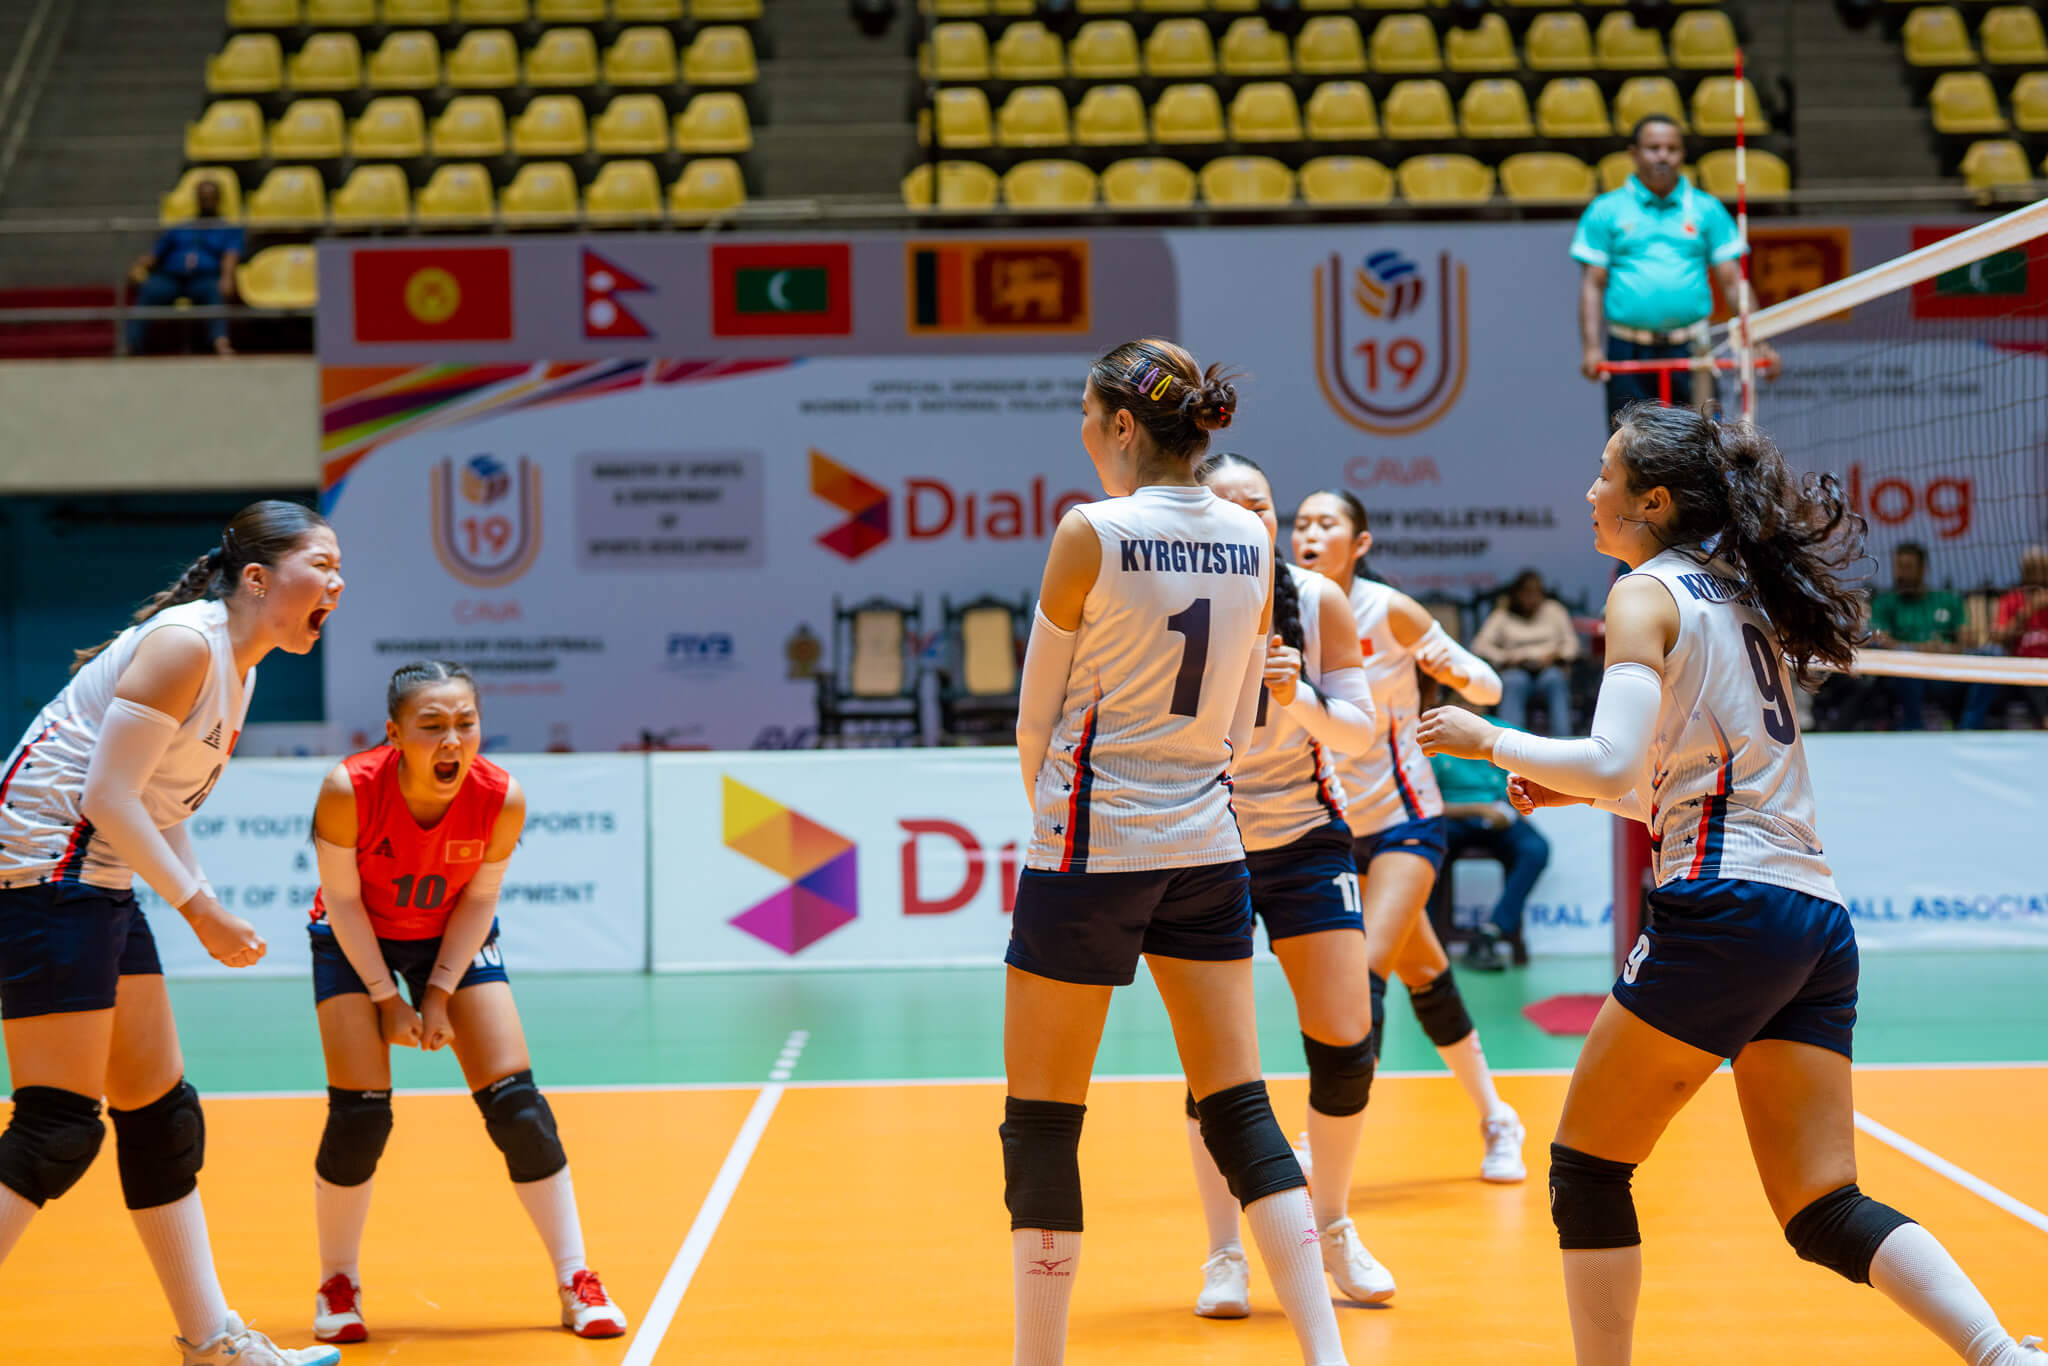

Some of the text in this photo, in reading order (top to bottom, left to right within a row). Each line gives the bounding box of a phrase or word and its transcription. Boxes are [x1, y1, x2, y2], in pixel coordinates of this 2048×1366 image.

[1355, 336, 1427, 393] 19
[1848, 461, 1973, 540] log
[462, 516, 512, 557] 19
[1120, 539, 1260, 577] KYRGYZSTAN
[1167, 598, 1211, 718] 1
[1742, 623, 1796, 745] 9
[526, 812, 617, 834] PORTS
[392, 873, 447, 909] 10
[1909, 892, 2048, 922] ASSOCIA
[1623, 934, 1650, 984] 9
